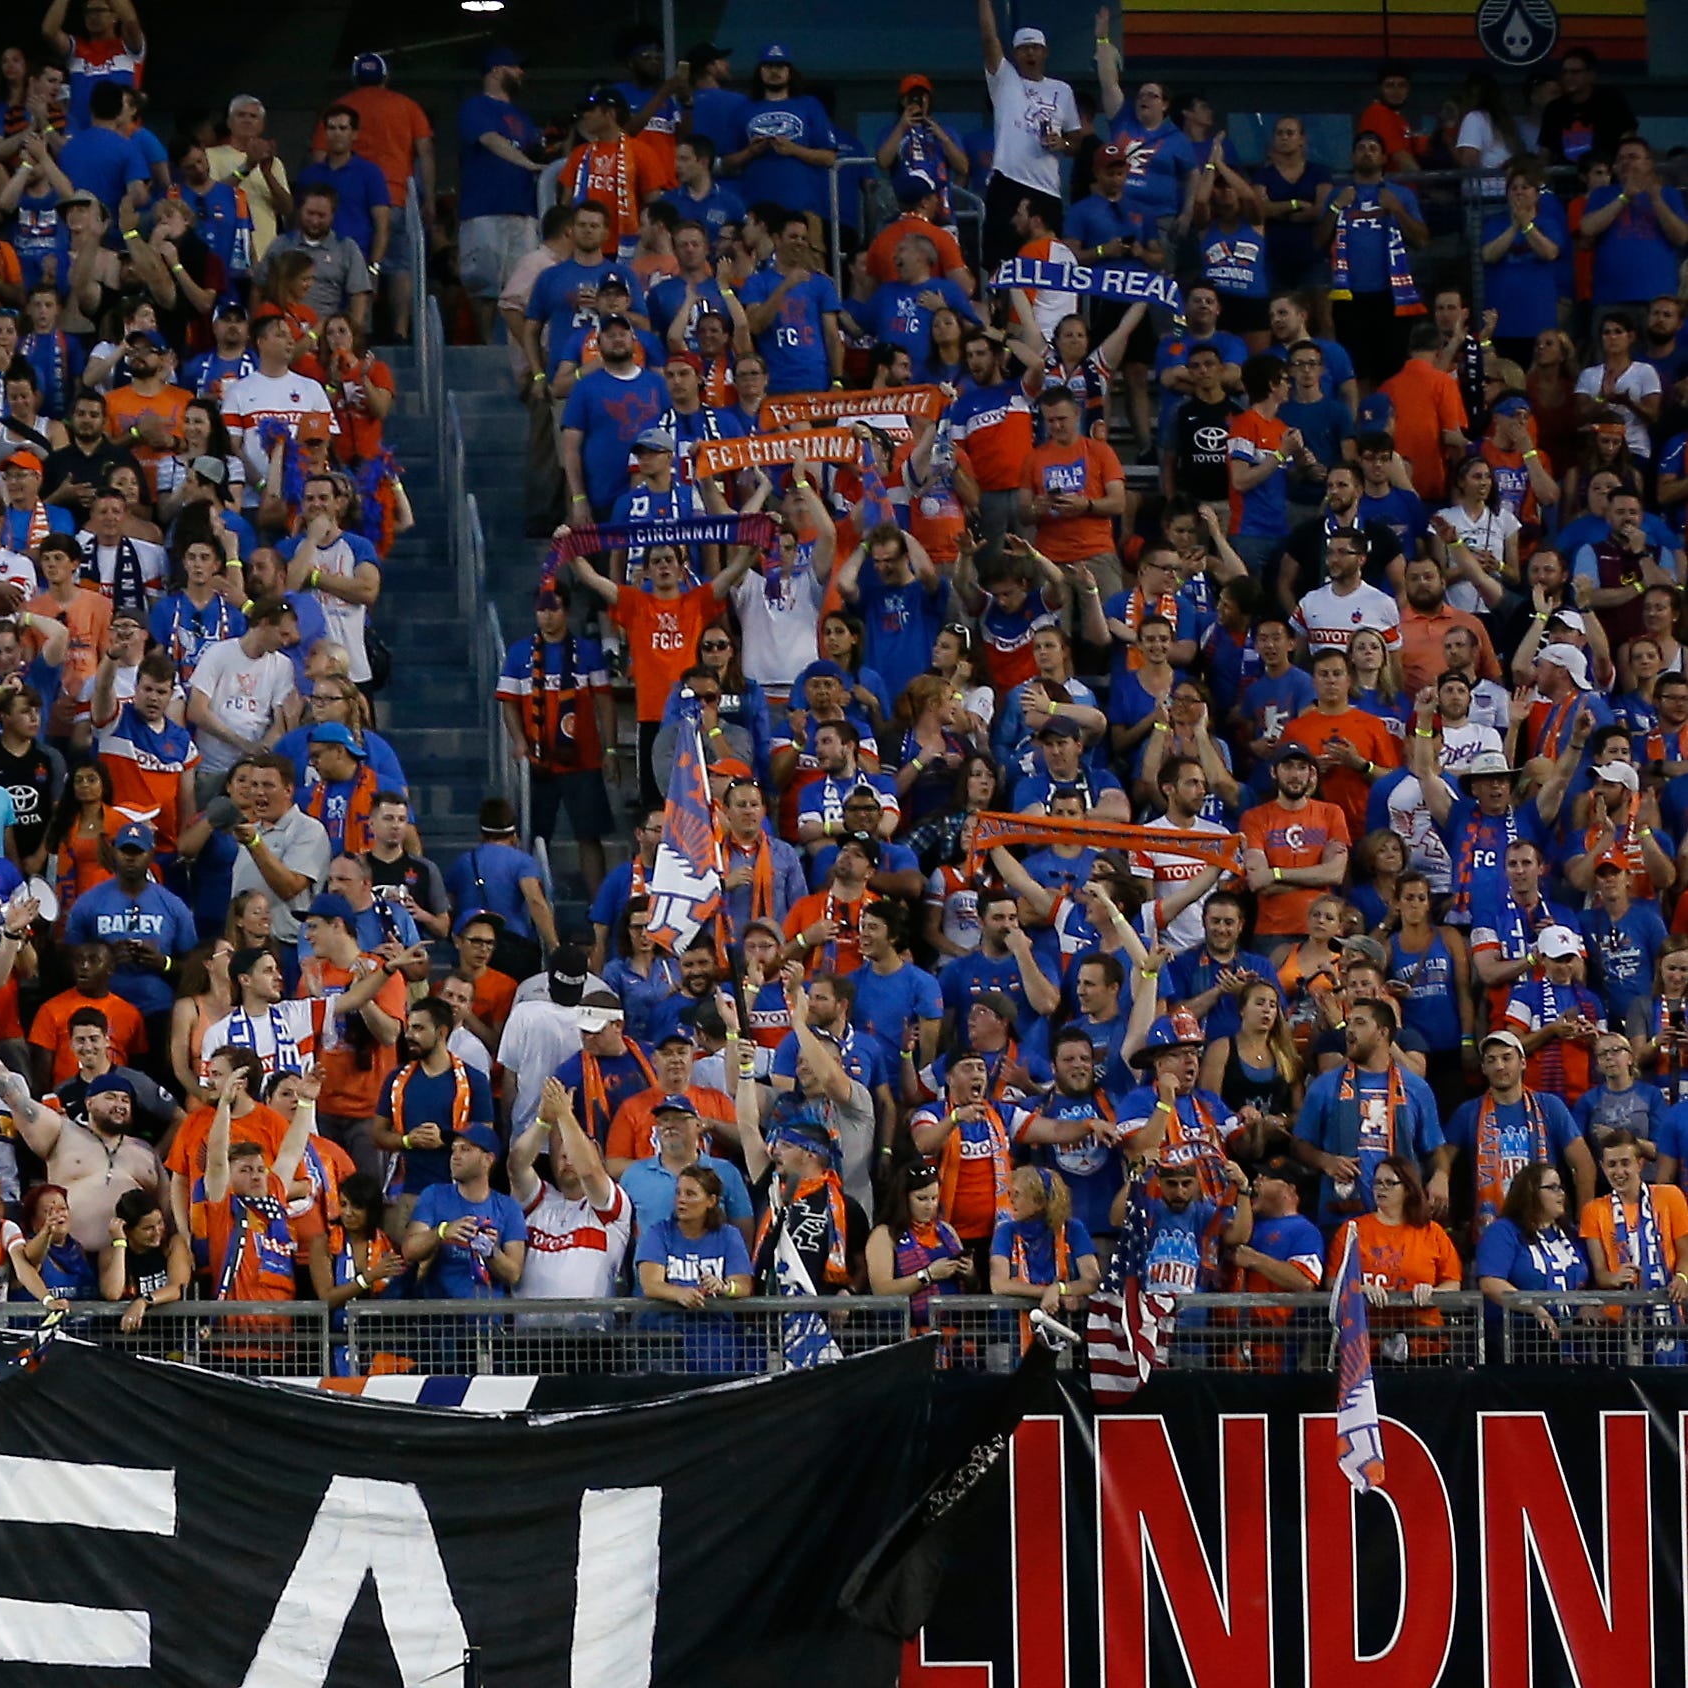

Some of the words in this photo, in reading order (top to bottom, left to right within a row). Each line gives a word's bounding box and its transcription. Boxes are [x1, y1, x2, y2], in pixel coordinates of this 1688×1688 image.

[998, 257, 1053, 287] ELL
[1061, 264, 1093, 289] IS
[1101, 268, 1181, 309] REAL
[769, 402, 797, 422] FC
[706, 445, 734, 470] FC
[746, 434, 857, 465] CINCINNA
[1163, 865, 1206, 879] TOYO
